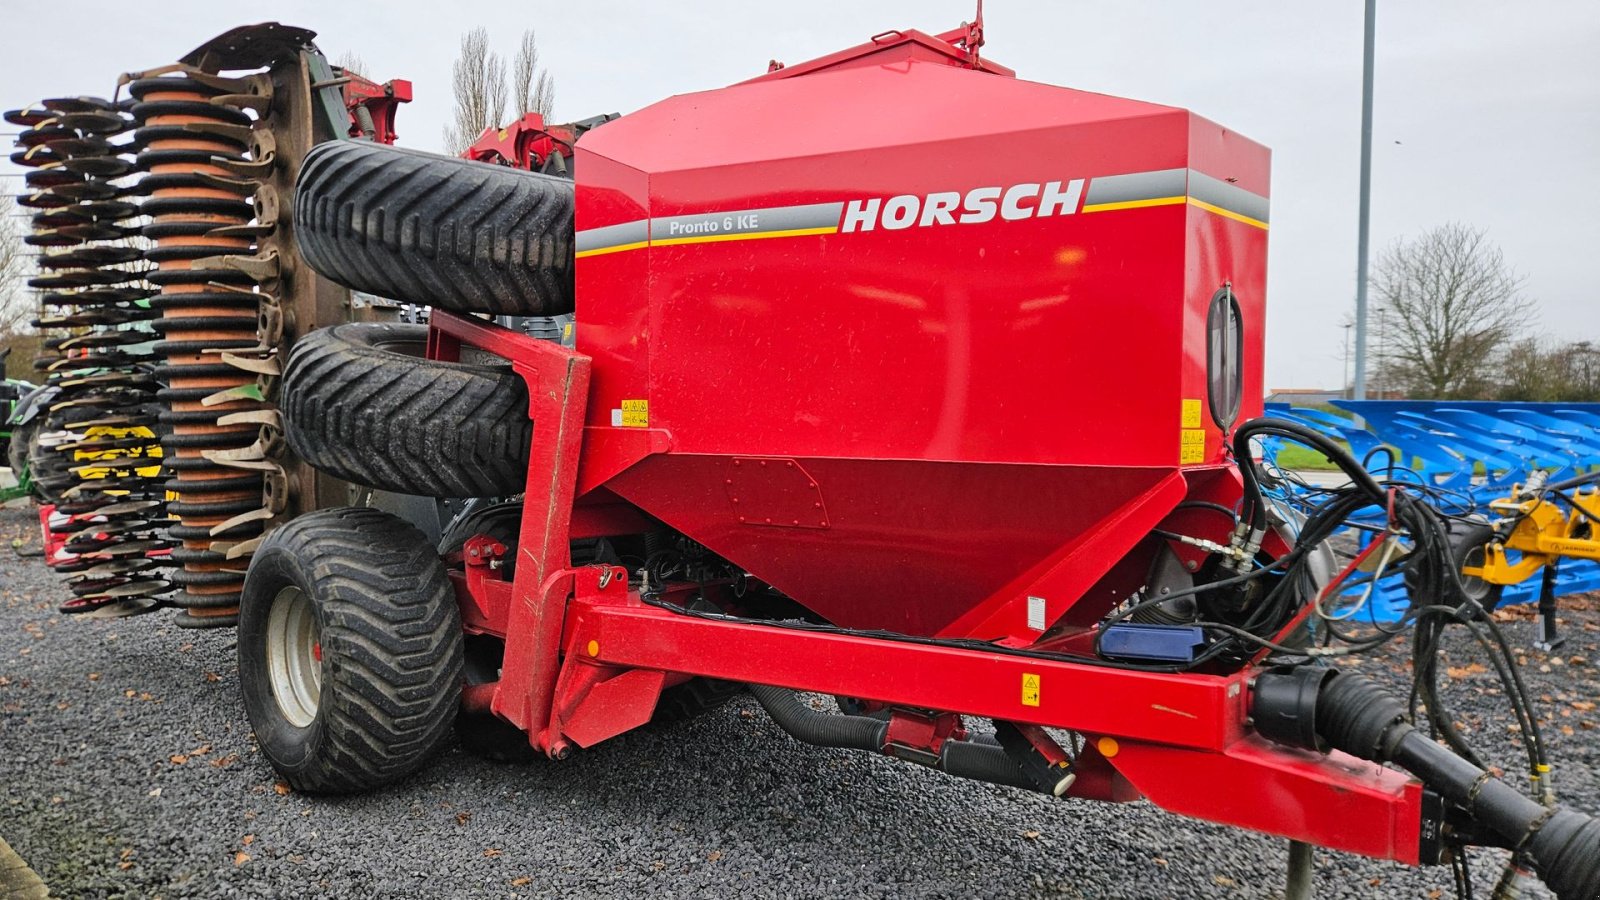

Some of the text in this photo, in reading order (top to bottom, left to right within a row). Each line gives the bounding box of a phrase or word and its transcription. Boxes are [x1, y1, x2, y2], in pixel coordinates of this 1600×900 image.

[670, 214, 759, 235] Pronto 6 KE
[842, 179, 1085, 233] HORSCH
